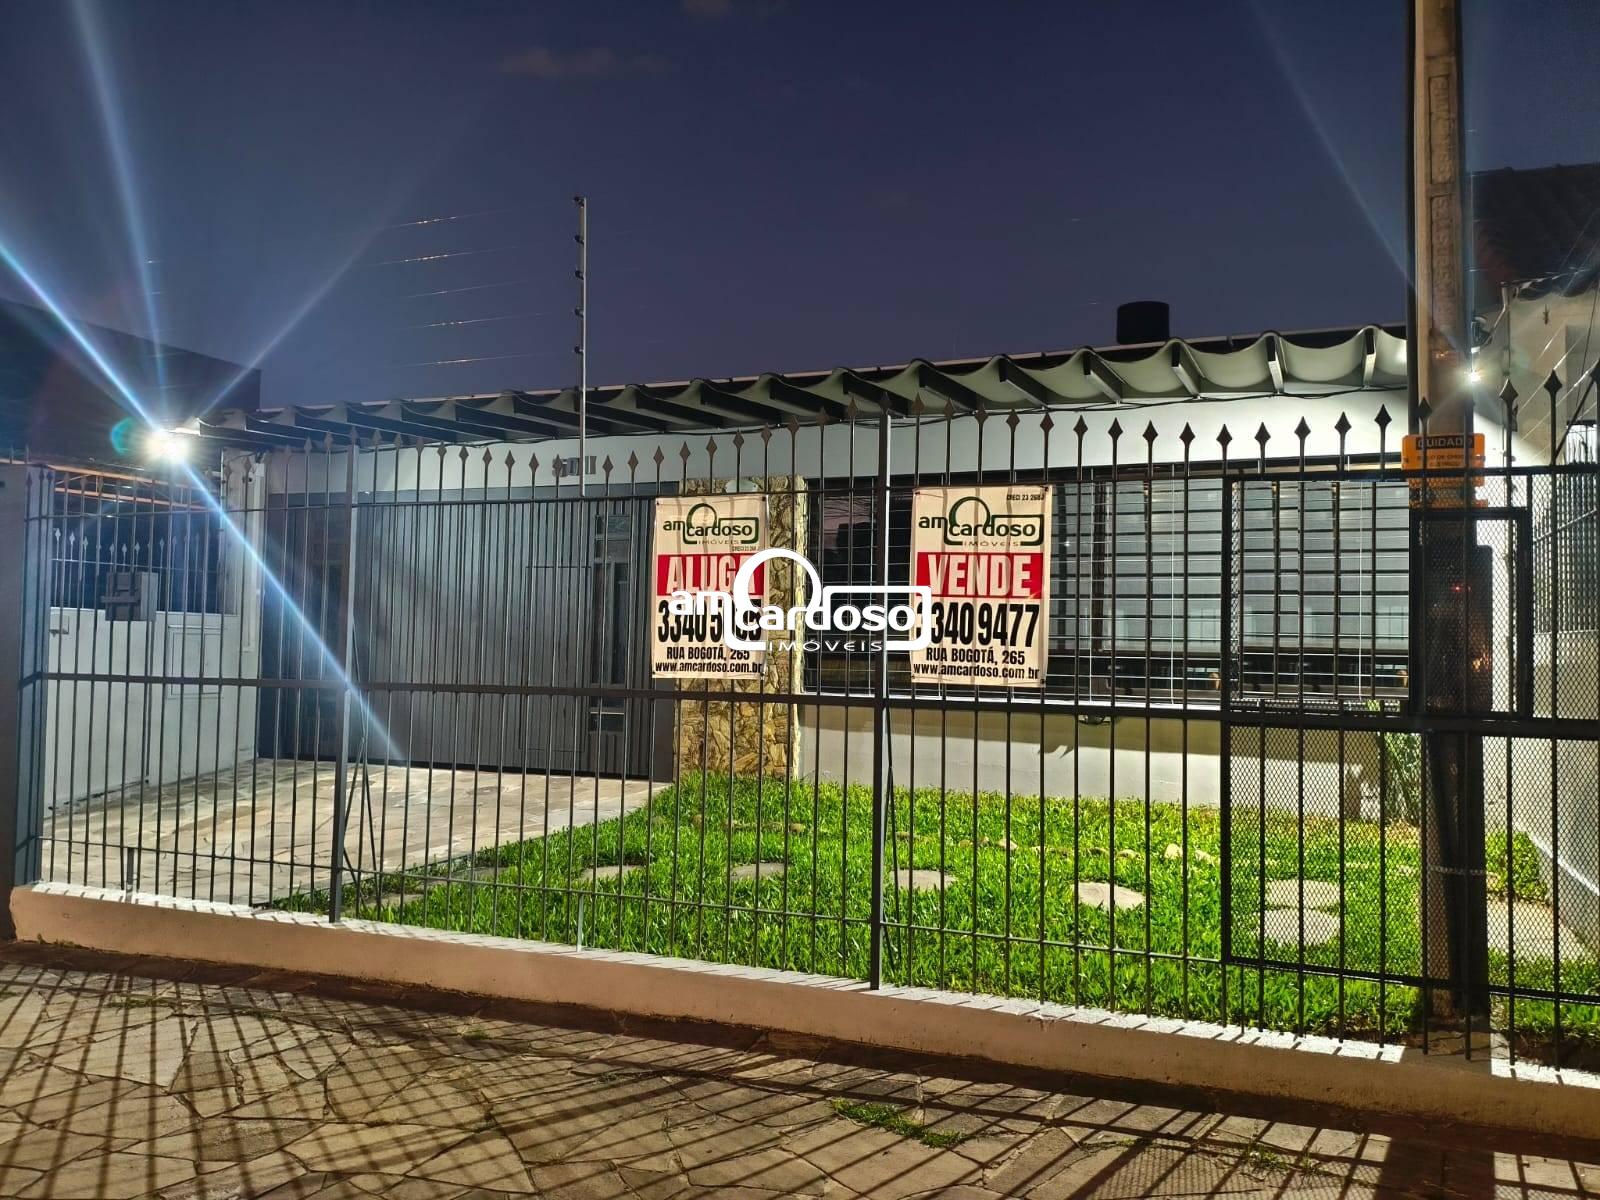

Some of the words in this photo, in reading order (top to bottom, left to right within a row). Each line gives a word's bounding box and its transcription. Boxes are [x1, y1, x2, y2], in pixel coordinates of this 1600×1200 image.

[1417, 437, 1472, 448] CUIDAD
[928, 554, 1032, 597] VENDE
[666, 646, 685, 660] RUA
[688, 644, 727, 661] BOGOTÁ,
[730, 649, 750, 660] 265
[926, 647, 948, 662] RUA
[951, 646, 998, 665] BOGOTÁ,
[1001, 650, 1025, 665] 265
[655, 661, 763, 673] www.amcardoso.com.br
